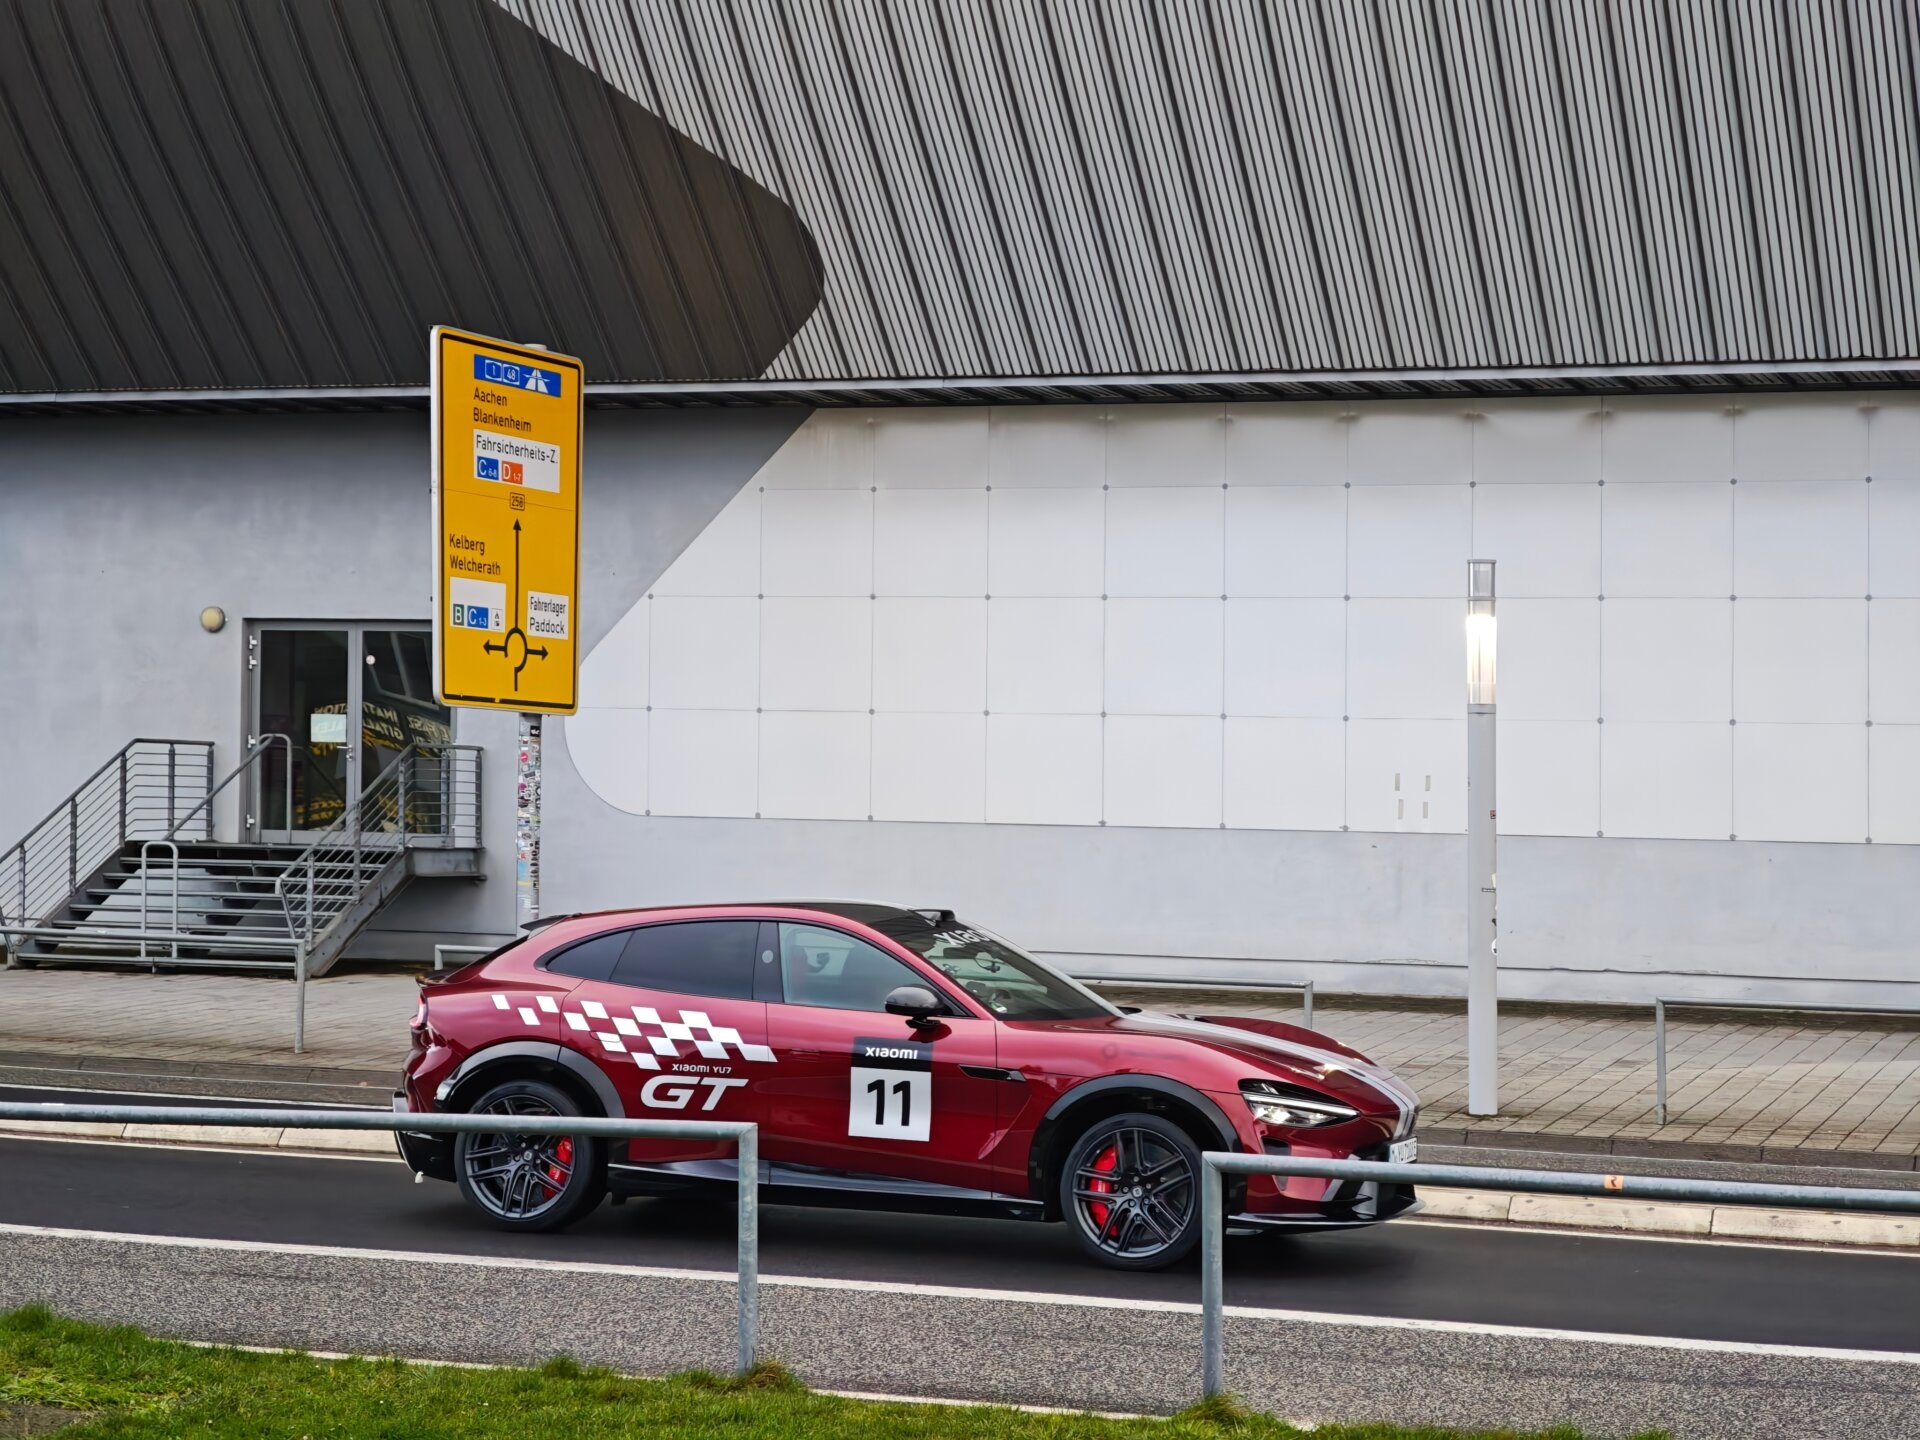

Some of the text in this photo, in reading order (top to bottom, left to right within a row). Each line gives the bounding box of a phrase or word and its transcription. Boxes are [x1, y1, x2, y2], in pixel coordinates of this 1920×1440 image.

[506, 368, 516, 381] 48
[473, 387, 507, 406] Aachen
[473, 407, 531, 432] Blankenheim
[449, 533, 485, 556] Kelberg
[449, 555, 501, 576] Welcherath
[455, 606, 462, 623] B
[529, 597, 566, 616] Fahrerlager
[529, 617, 565, 635] Paddock
[713, 1066, 732, 1074] YU7
[641, 1075, 749, 1111] GT
[867, 1079, 911, 1127] 11
